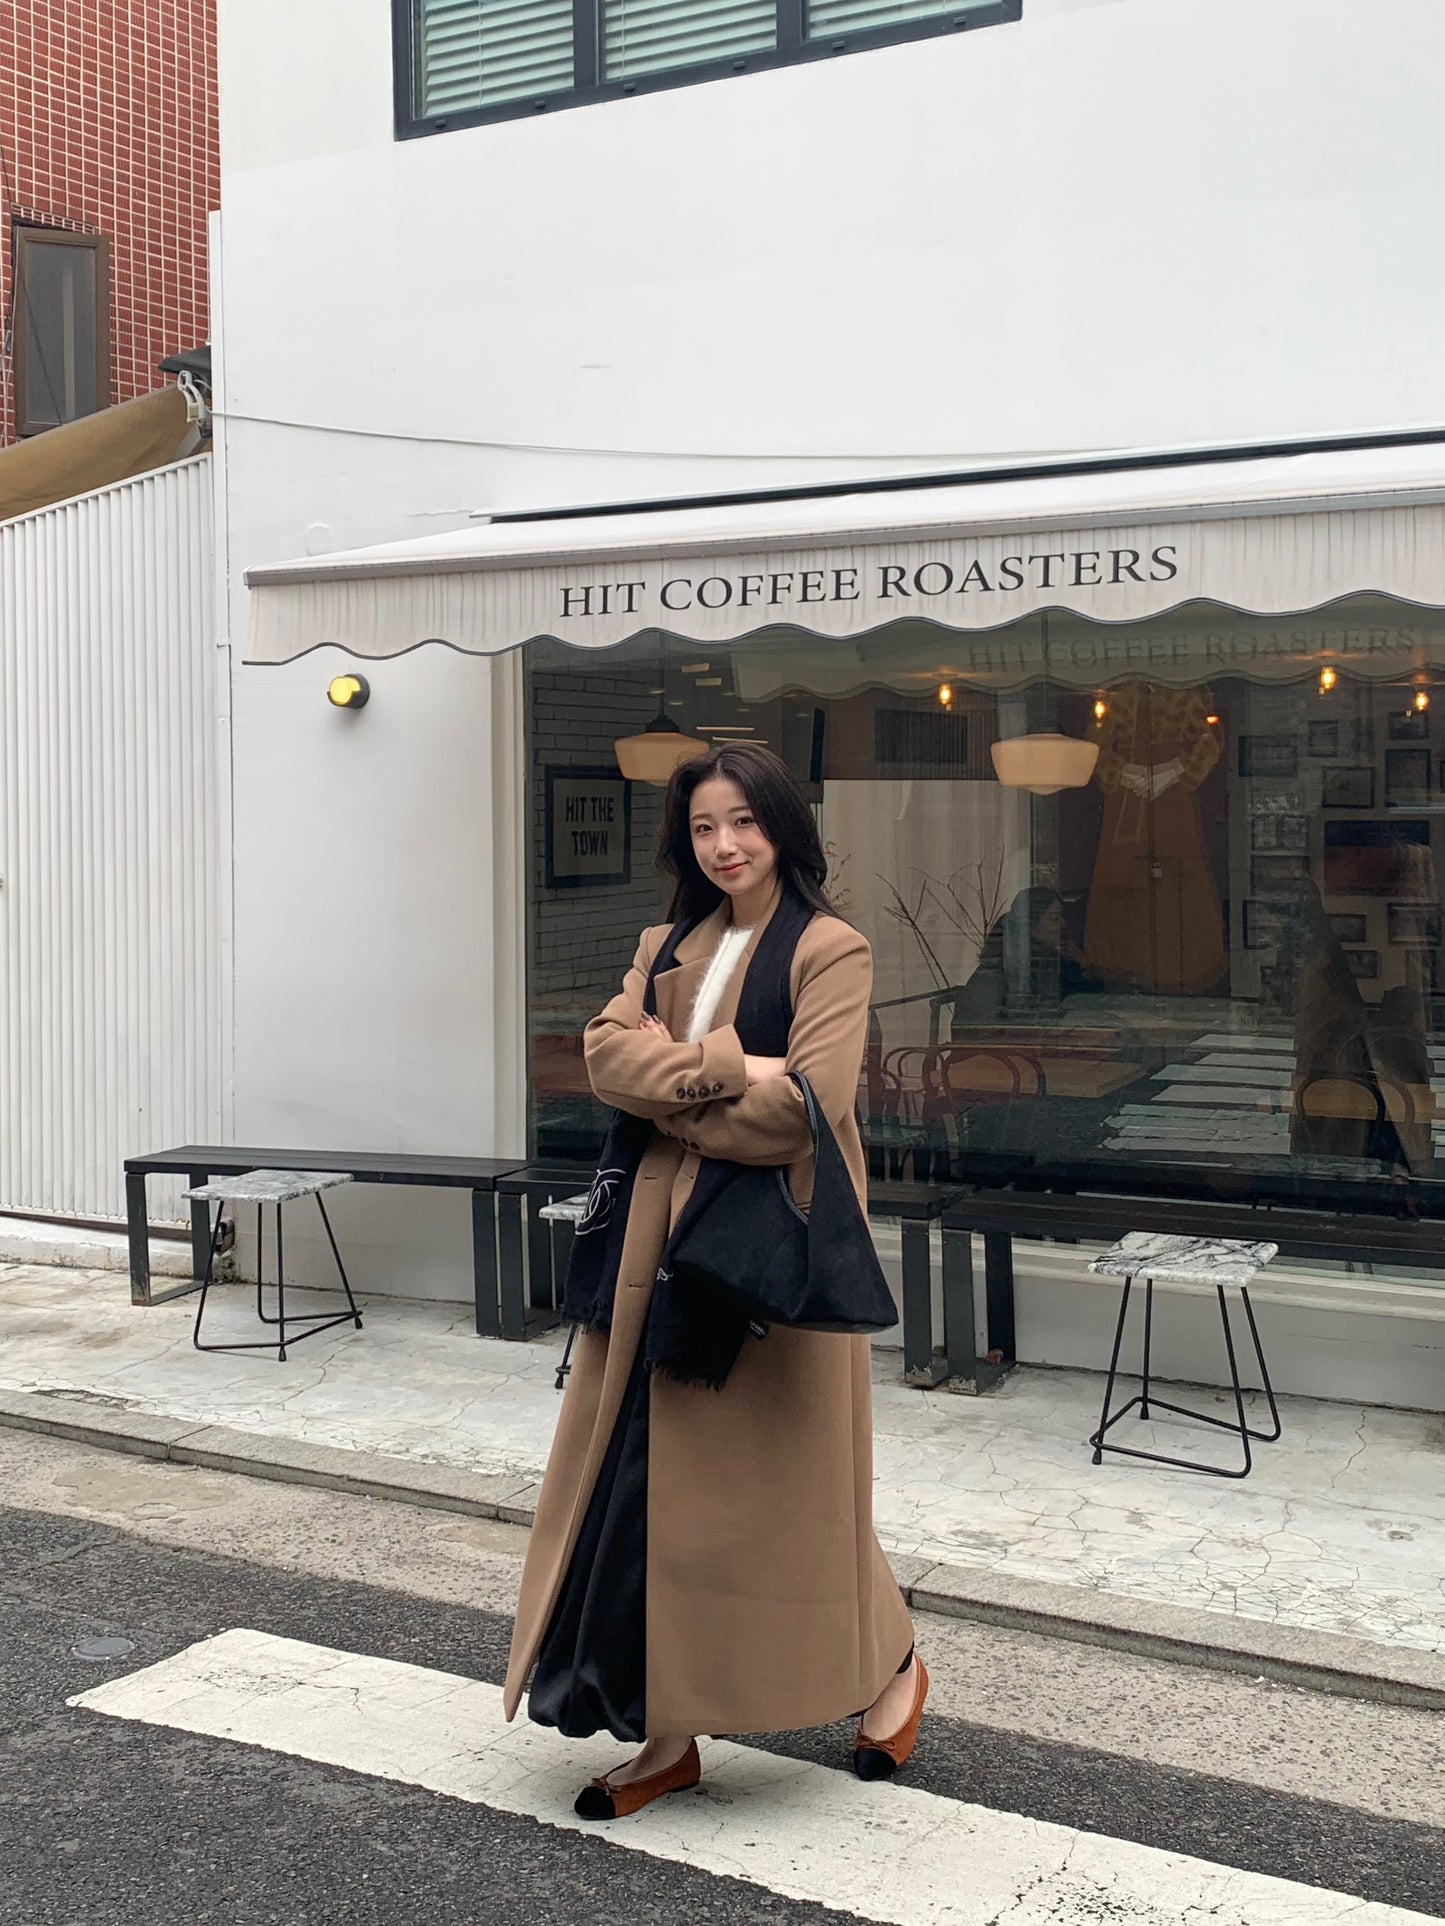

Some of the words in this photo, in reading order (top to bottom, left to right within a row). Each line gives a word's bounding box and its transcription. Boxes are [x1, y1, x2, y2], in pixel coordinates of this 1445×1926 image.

[559, 581, 646, 618] HIT
[660, 568, 861, 613] COFFEE
[877, 546, 1179, 600] ROASTERS
[967, 640, 1032, 673] HIT
[1046, 634, 1189, 670] COFFEE
[1205, 625, 1415, 663] ROASTERS
[566, 796, 587, 822] HIT
[591, 796, 614, 822] THE
[571, 830, 609, 856] TOWN
